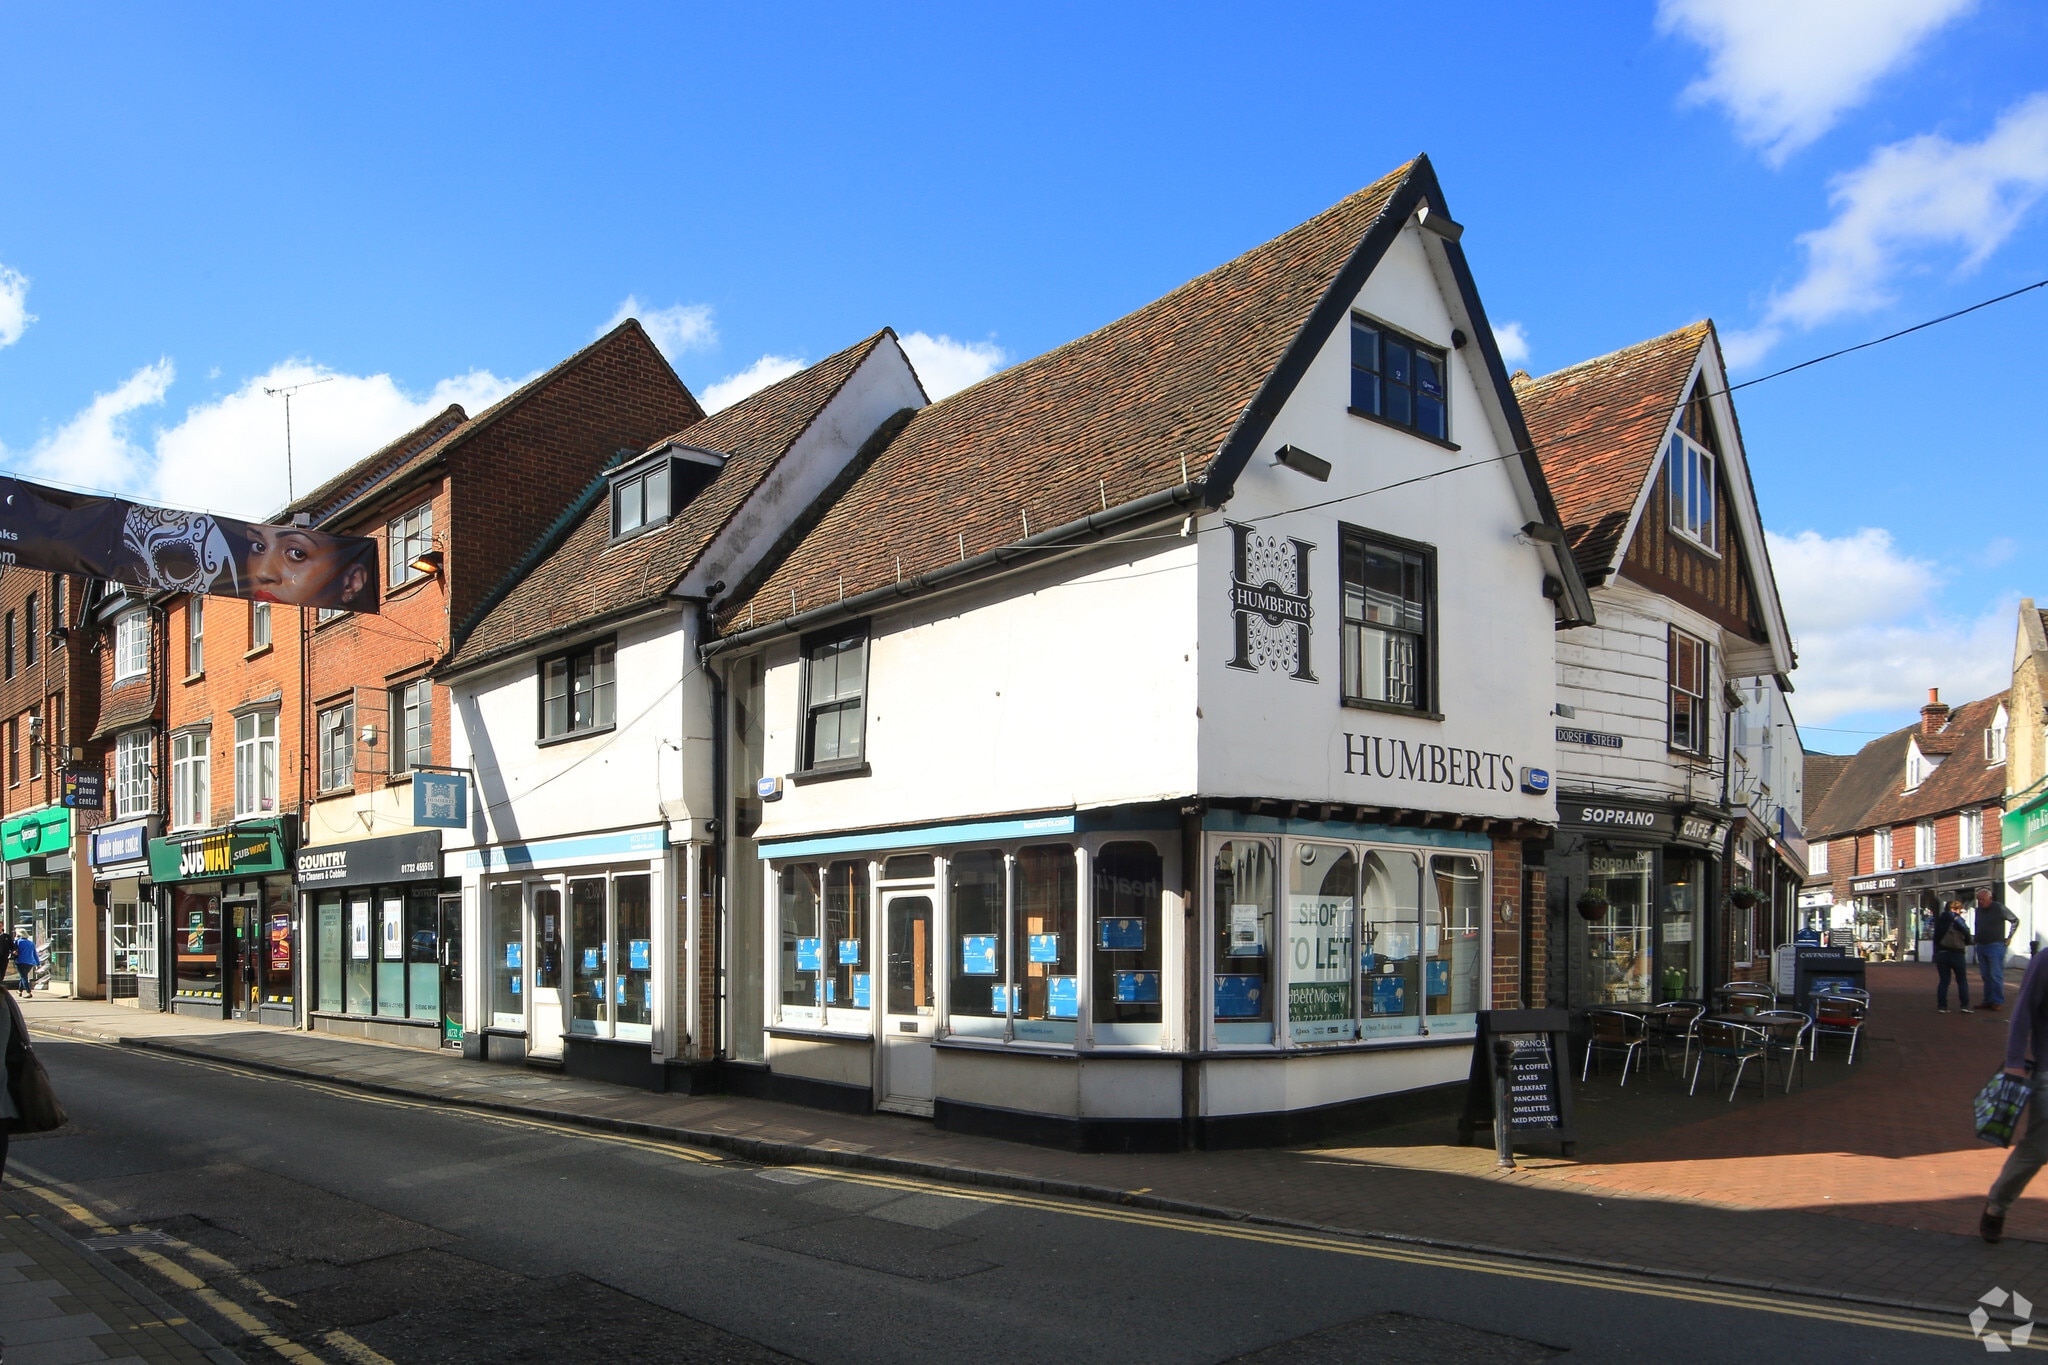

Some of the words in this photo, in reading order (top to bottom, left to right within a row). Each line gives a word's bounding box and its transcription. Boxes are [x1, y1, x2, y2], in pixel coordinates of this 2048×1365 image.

[0, 551, 16, 564] m
[1237, 588, 1307, 619] HUMBERTS
[1557, 729, 1589, 744] DORSET
[1592, 733, 1621, 748] STREET
[1343, 732, 1514, 793] HUMBERTS
[78, 776, 98, 785] mobile
[78, 787, 97, 796] phone
[78, 798, 98, 807] centre
[1581, 808, 1655, 826] SOPRANO
[1683, 820, 1711, 840] CAFE
[99, 838, 112, 859] mobile
[112, 836, 124, 859] phone
[125, 833, 139, 853] centre
[233, 842, 269, 861] SUBWAY
[179, 834, 234, 876] SUBWAY
[298, 851, 347, 870] COUNTRY
[467, 849, 508, 868] HUMBERTS
[298, 872, 306, 884] Dry
[306, 870, 325, 881] Cleaners
[325, 870, 329, 879] &
[329, 868, 347, 880] Cobbler
[401, 863, 416, 874] 01732
[1853, 880, 1877, 892] VINTAGE
[1878, 877, 1896, 889] ATTIC
[1299, 902, 1338, 927] SHOP
[1315, 936, 1352, 969] LET
[1525, 1063, 1549, 1071] COFFEE
[1511, 1084, 1547, 1092] BREAKFAST
[1514, 1094, 1547, 1102] PANCAKES
[1513, 1104, 1550, 1113] OMELETTES
[1528, 1114, 1559, 1123] POTATOES
